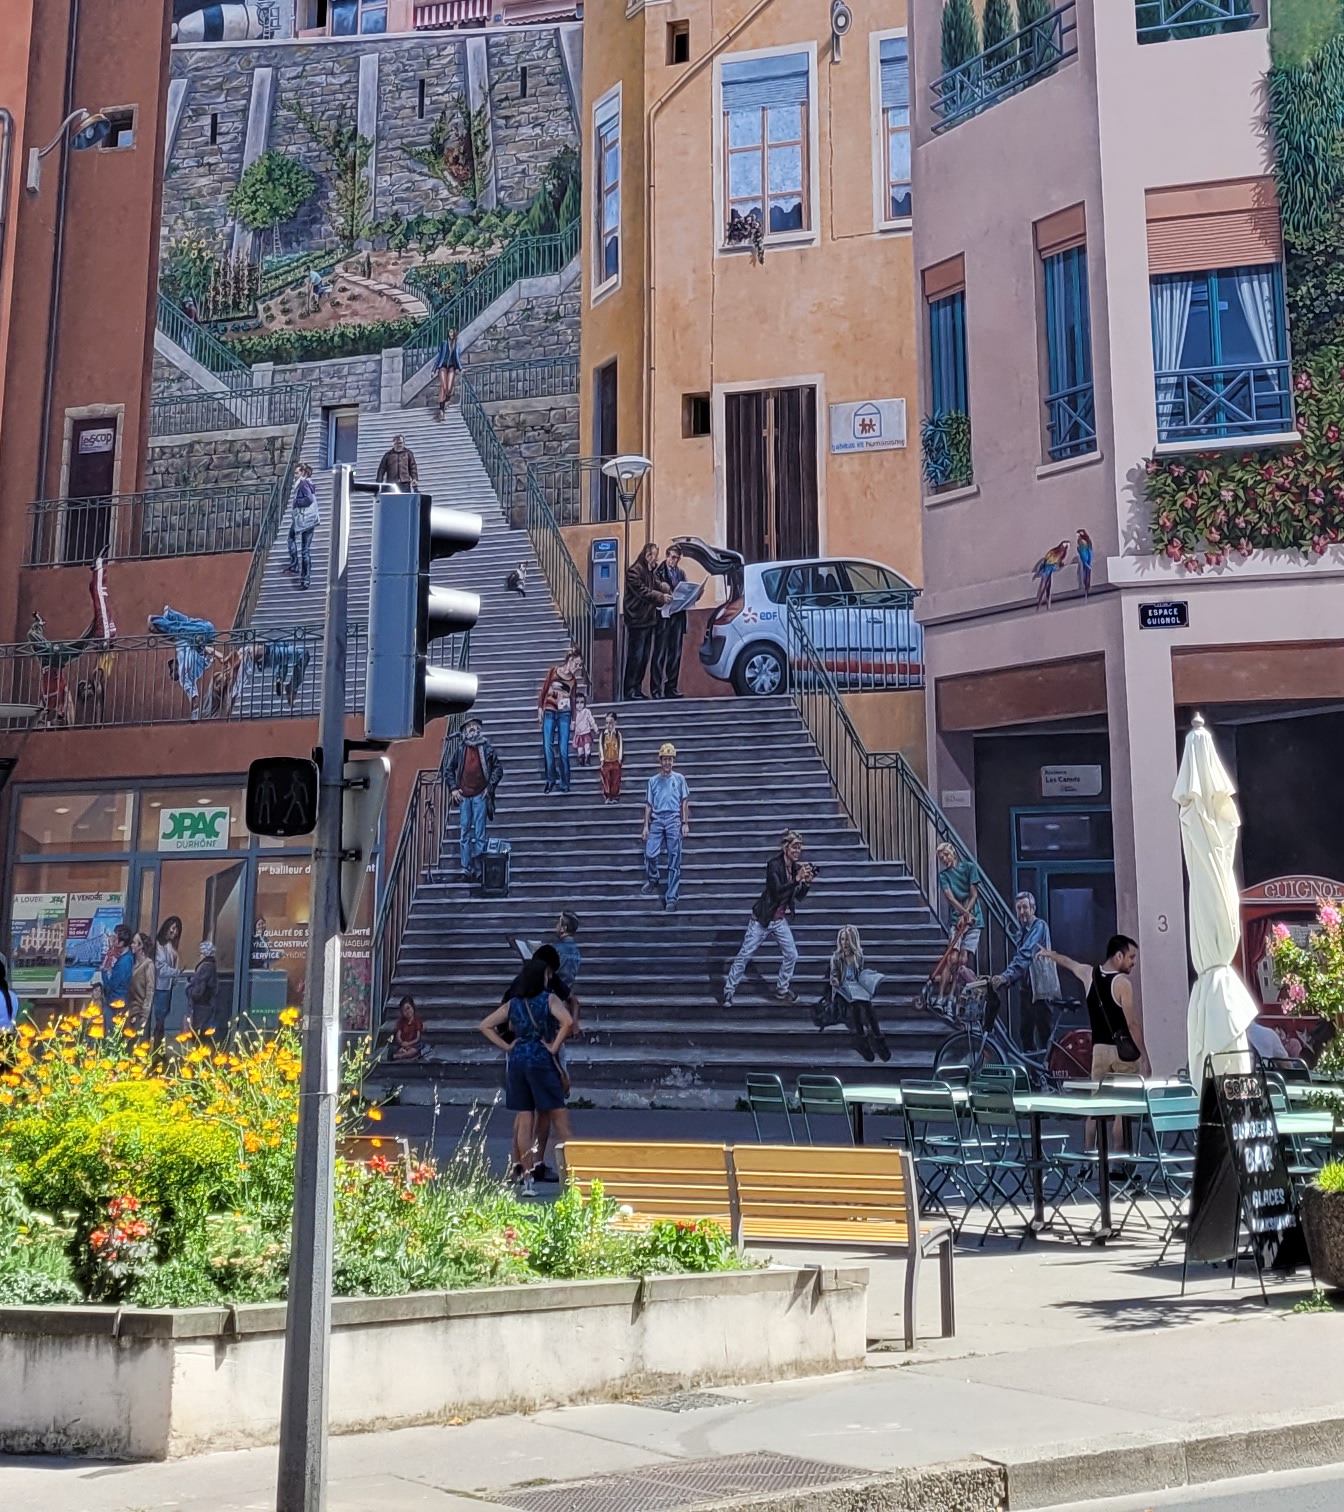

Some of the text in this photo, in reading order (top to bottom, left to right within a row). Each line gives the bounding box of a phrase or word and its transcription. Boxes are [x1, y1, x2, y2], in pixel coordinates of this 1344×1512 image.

[1148, 607, 1179, 616] ESPACE
[1146, 616, 1181, 626] GUIGNOL
[269, 865, 303, 875] bailleur
[1264, 880, 1342, 898] GUIGNOL
[1158, 914, 1168, 933] 3
[1252, 1188, 1285, 1208] GLACES
